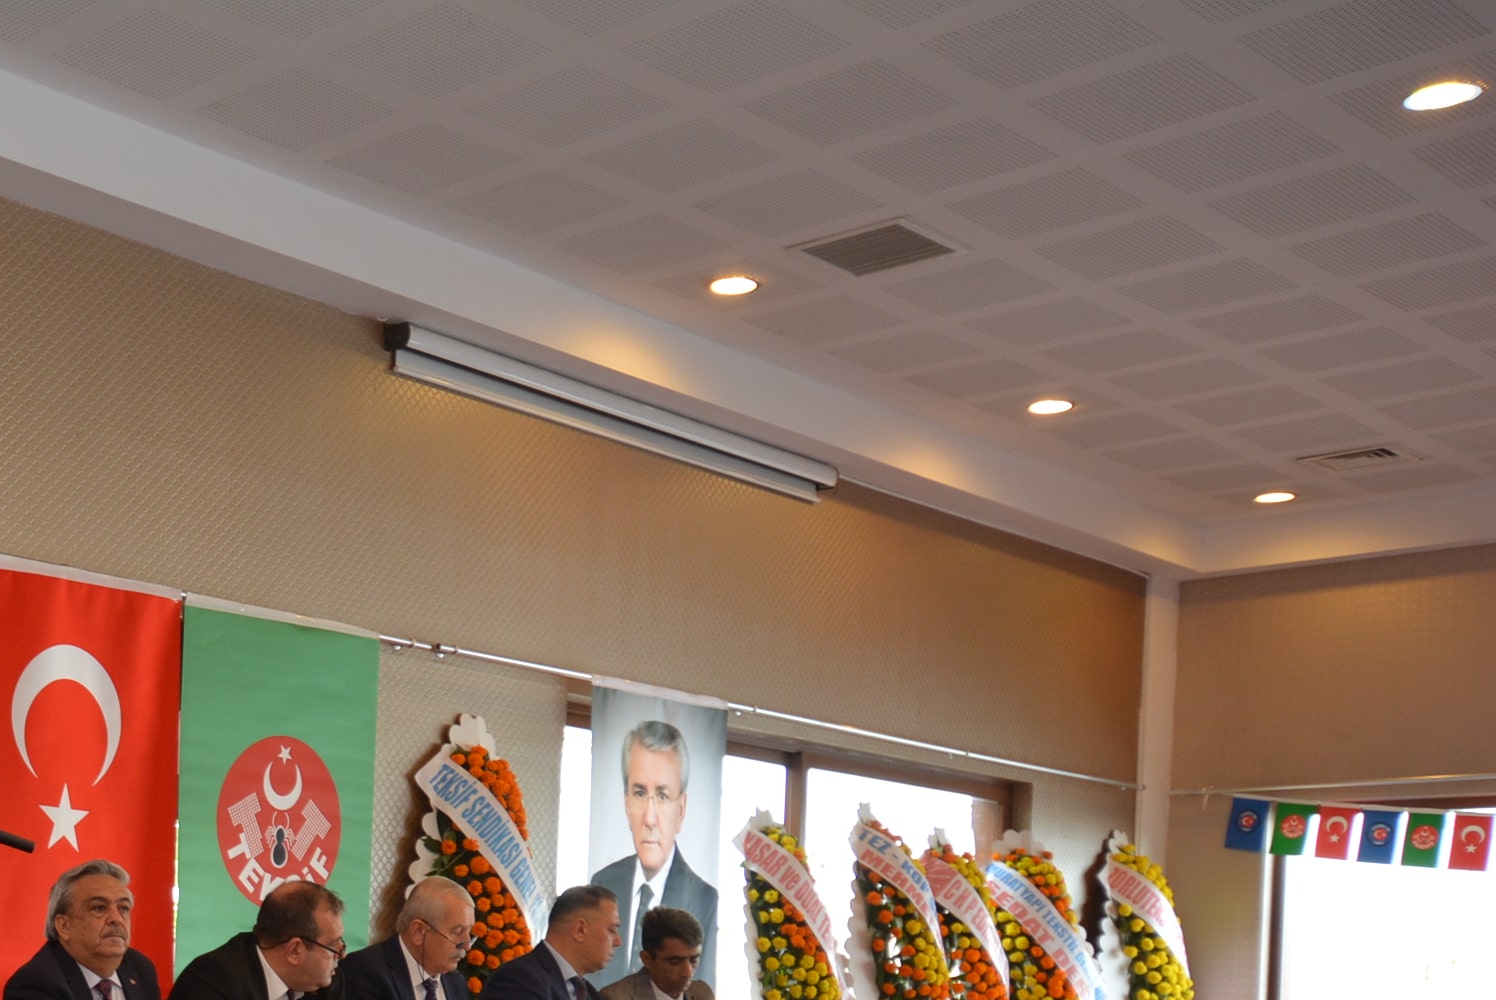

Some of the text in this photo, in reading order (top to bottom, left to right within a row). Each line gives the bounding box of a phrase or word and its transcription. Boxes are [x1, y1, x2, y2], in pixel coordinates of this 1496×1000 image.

[429, 763, 478, 811] TEKSİF
[461, 791, 523, 869] SENDİKASI
[859, 828, 892, 855] TEZ
[779, 866, 801, 891] ve
[986, 880, 1055, 945] SEDAT
